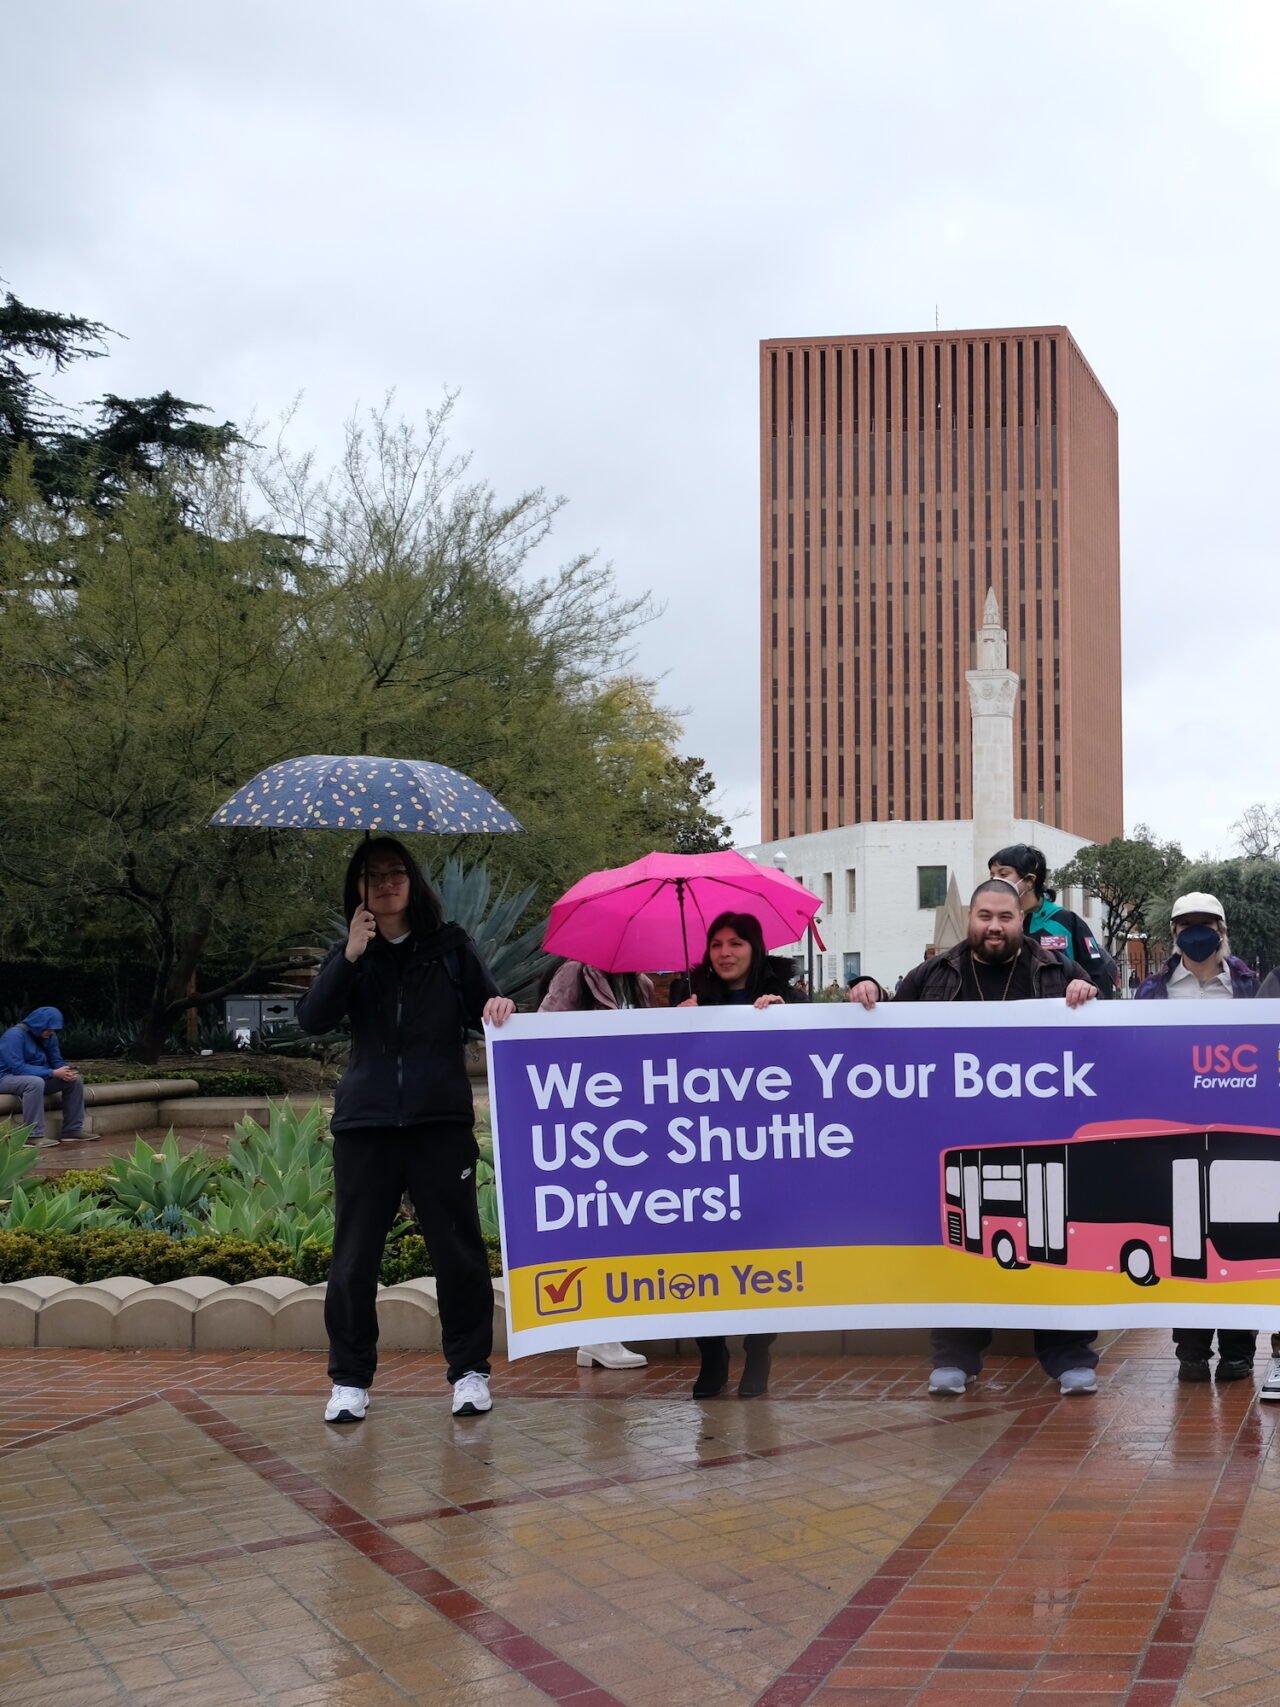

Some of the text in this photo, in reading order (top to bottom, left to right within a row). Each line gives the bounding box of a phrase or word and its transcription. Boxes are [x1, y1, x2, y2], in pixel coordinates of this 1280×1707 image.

[526, 1050, 1098, 1110] We Have Your Back
[1192, 1044, 1259, 1073] USC
[1193, 1074, 1257, 1089] Forward
[531, 1112, 854, 1171] USC Shuttle
[535, 1174, 742, 1232] Drivers!
[731, 1261, 805, 1295] Yes!
